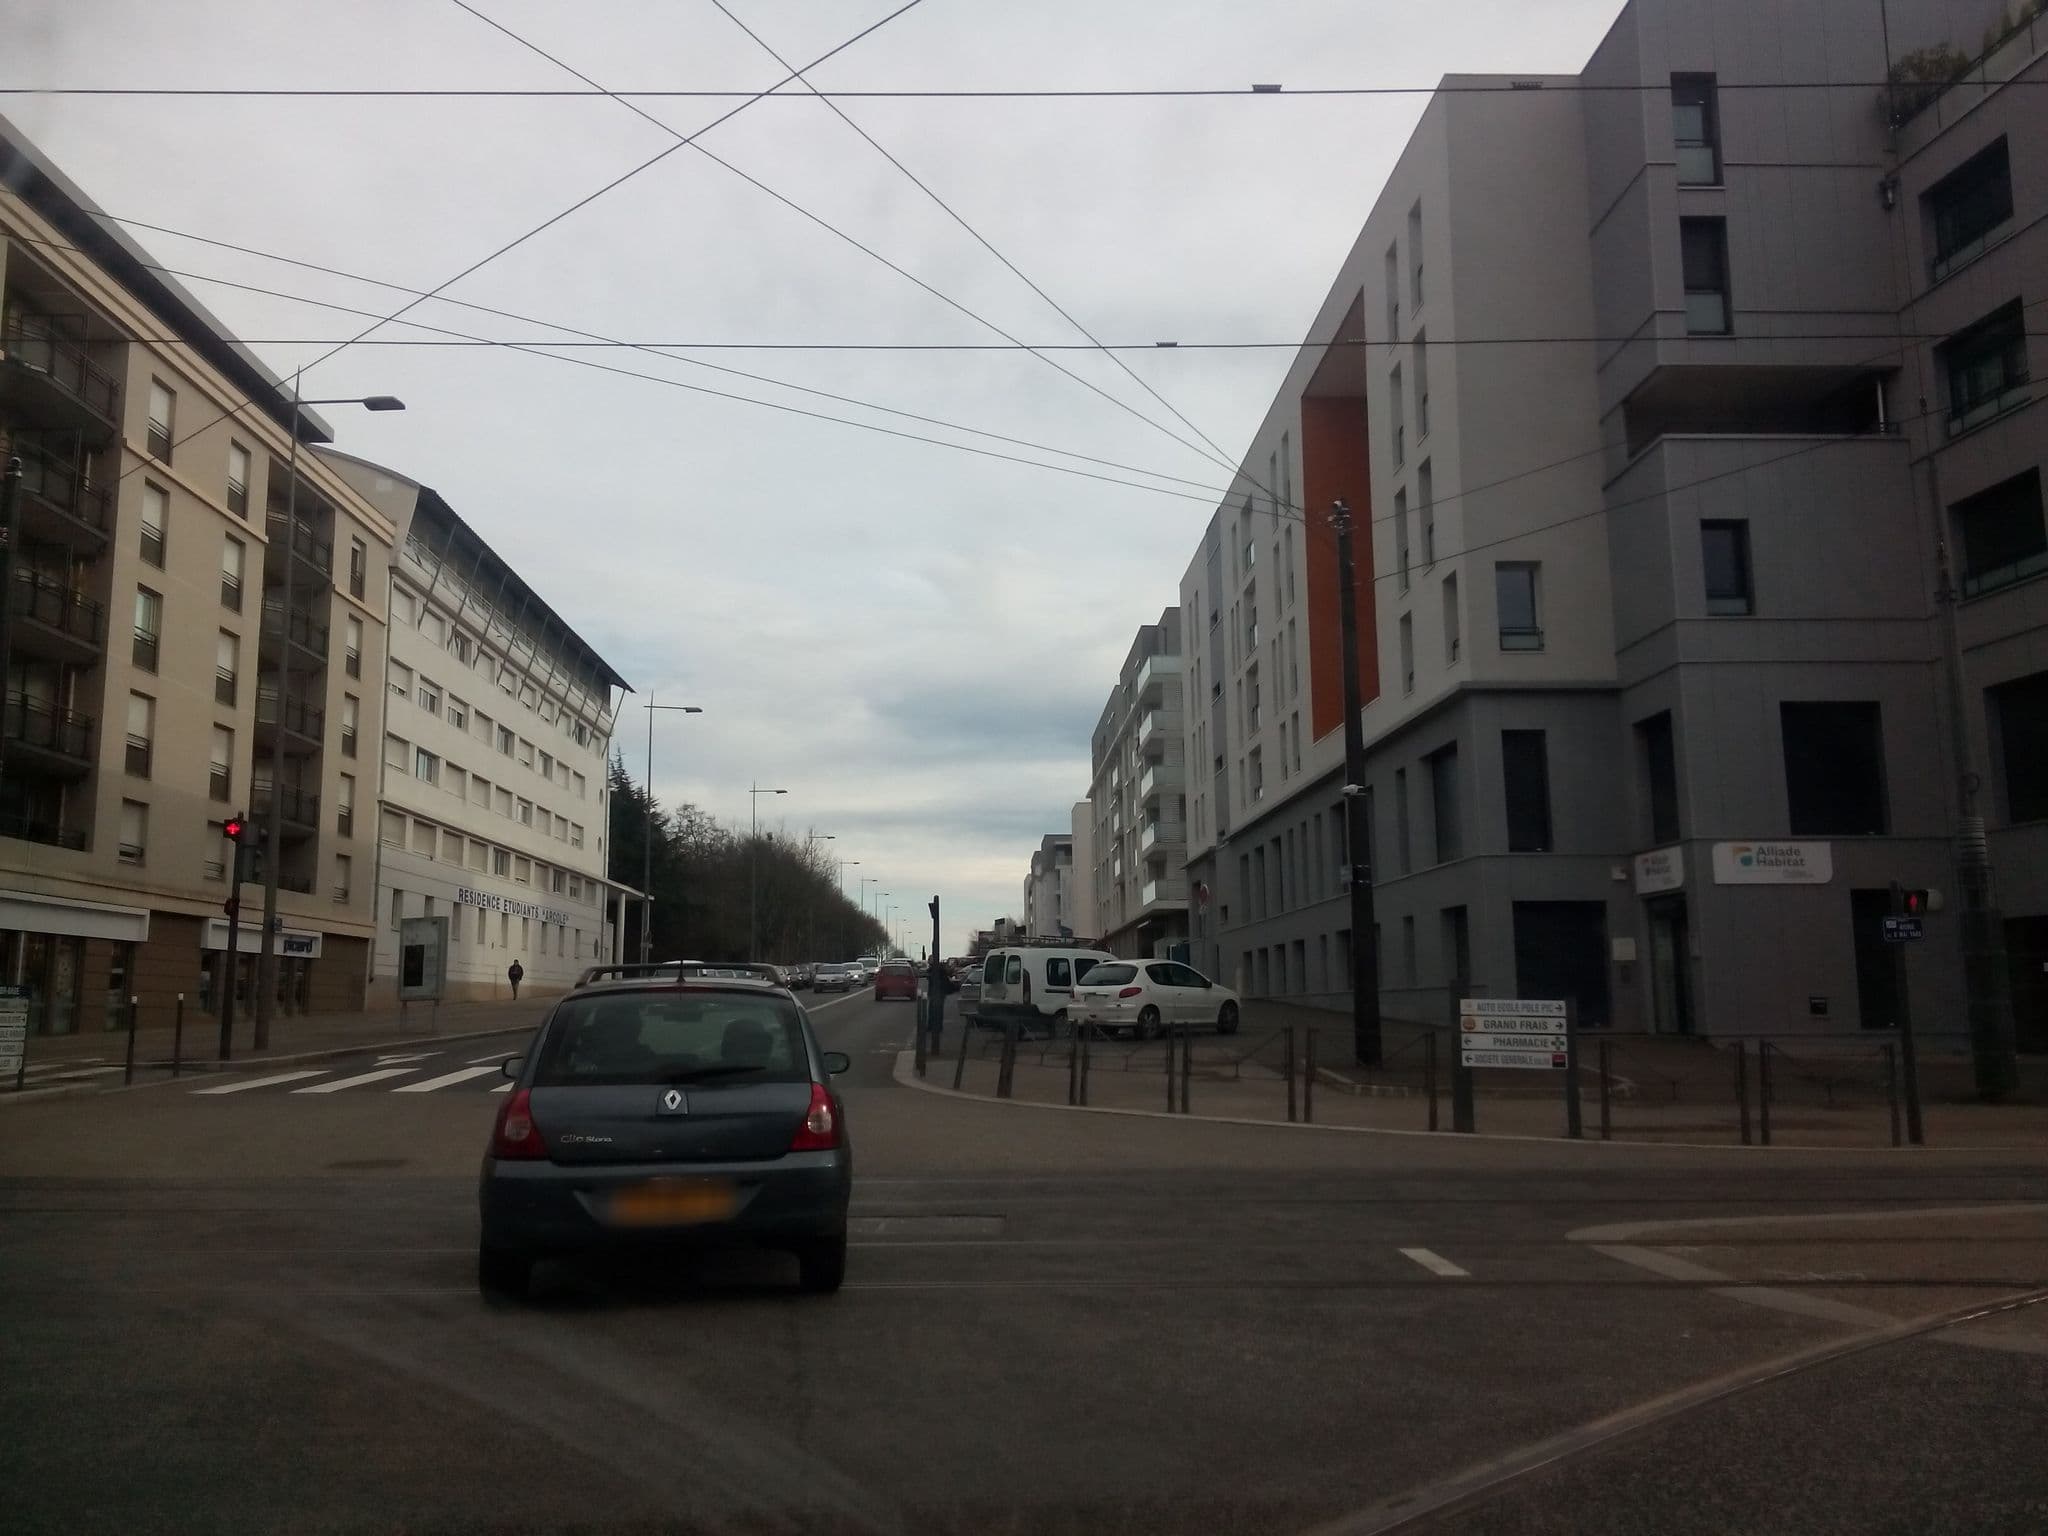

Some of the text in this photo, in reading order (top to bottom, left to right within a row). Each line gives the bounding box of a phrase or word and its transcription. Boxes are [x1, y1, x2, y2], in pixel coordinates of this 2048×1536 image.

[1757, 846, 1800, 857] Alliade
[1757, 857, 1806, 867] Habitat
[458, 888, 500, 910] RESIDENCE
[503, 899, 539, 919] ETUDIANTS
[1484, 1020, 1548, 1030] GRAND FRAIS
[1493, 1037, 1549, 1048] PHARMACIE
